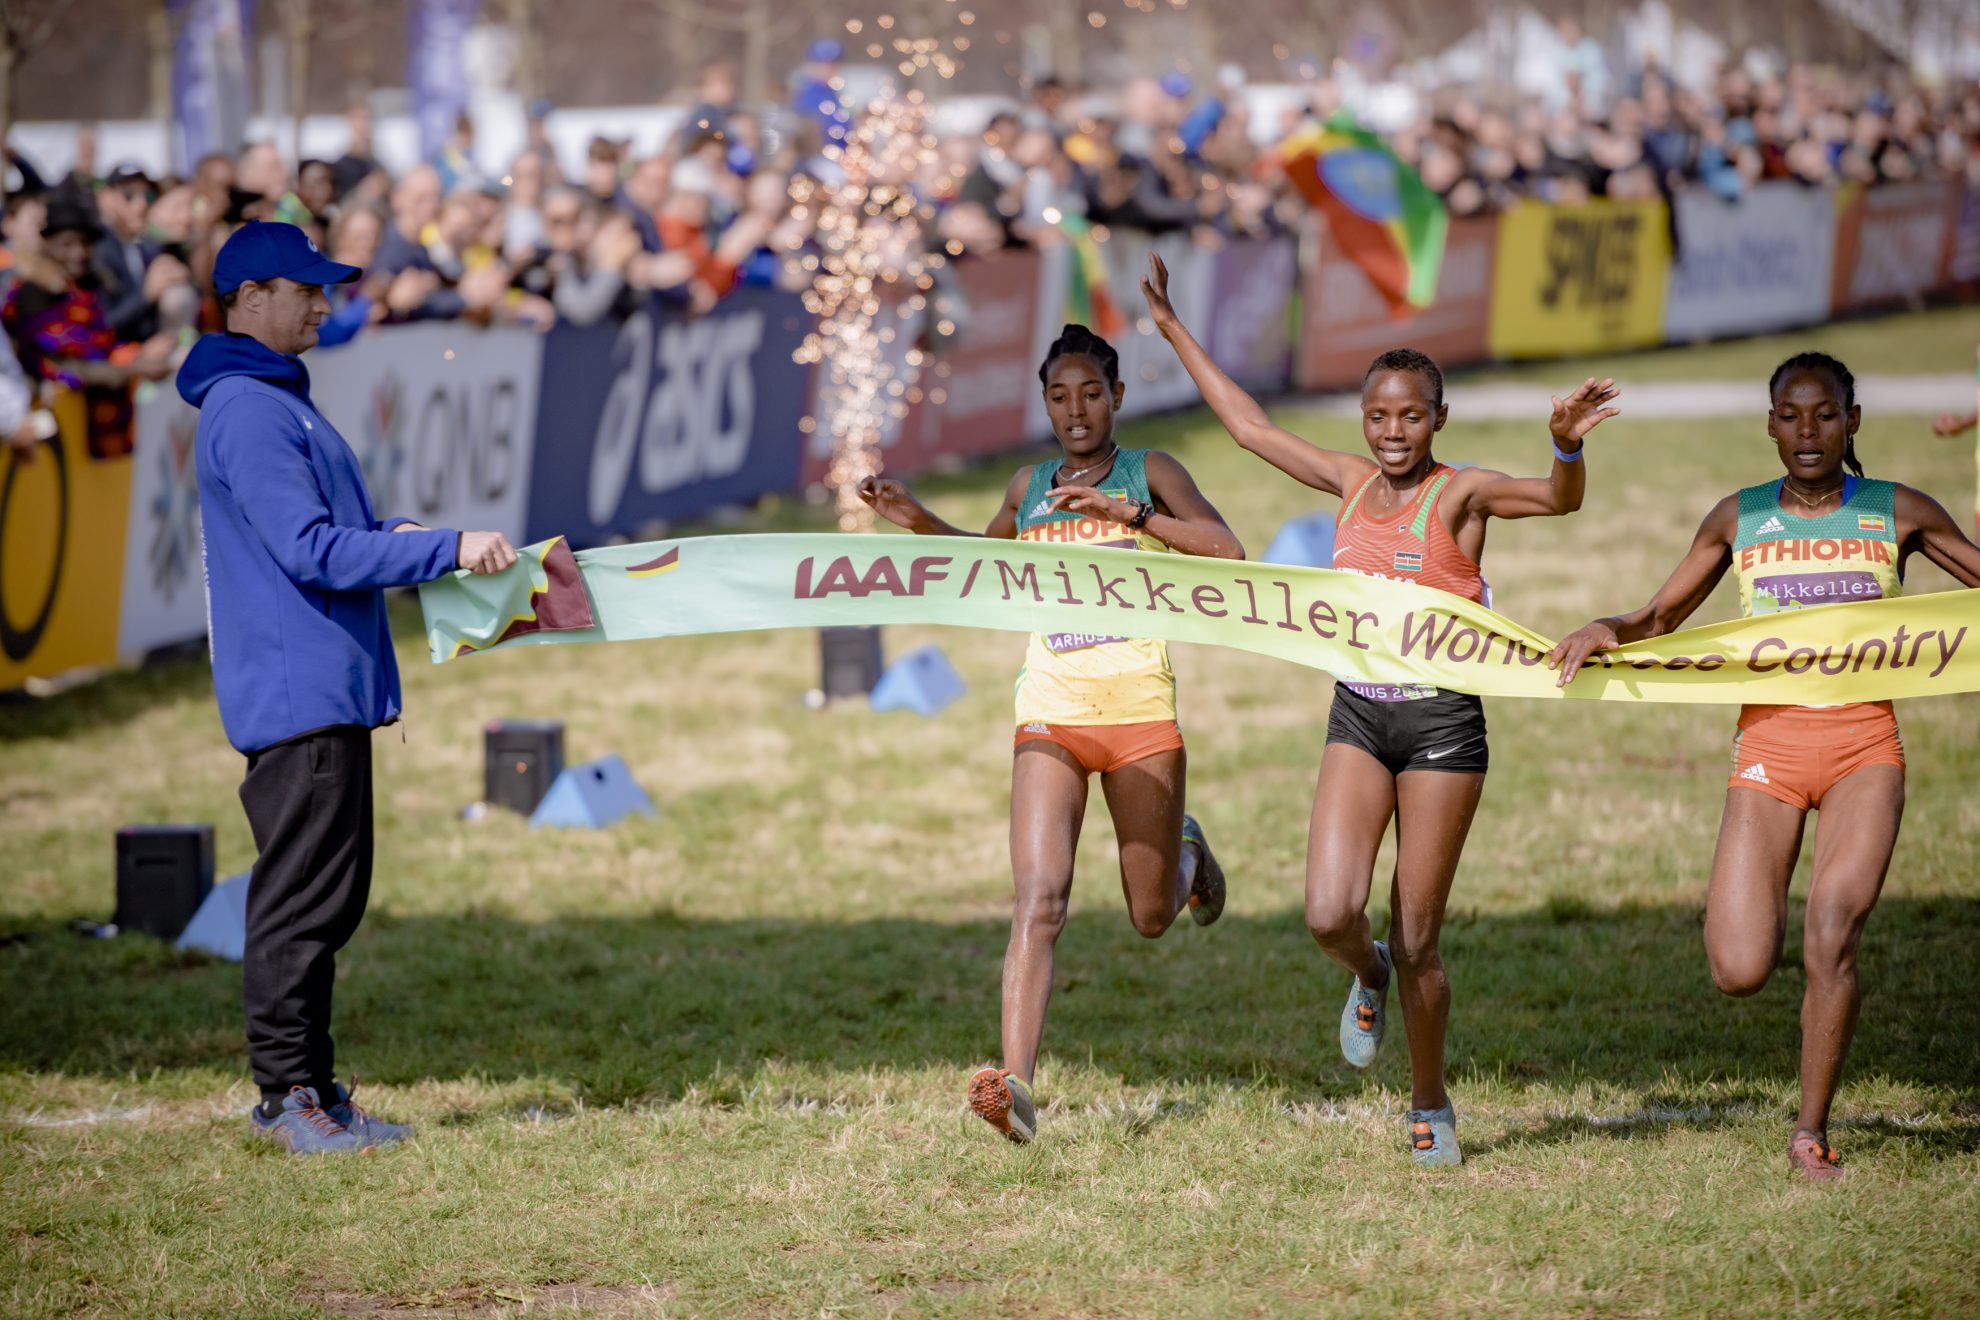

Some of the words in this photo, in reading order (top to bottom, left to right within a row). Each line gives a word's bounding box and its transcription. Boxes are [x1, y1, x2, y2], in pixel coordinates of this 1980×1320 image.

[1021, 517, 1136, 542] ETHIOPI
[1741, 538, 1891, 572] ETHIOPIA
[1756, 580, 1878, 600] Mikkeller
[1746, 624, 1968, 678] Country
